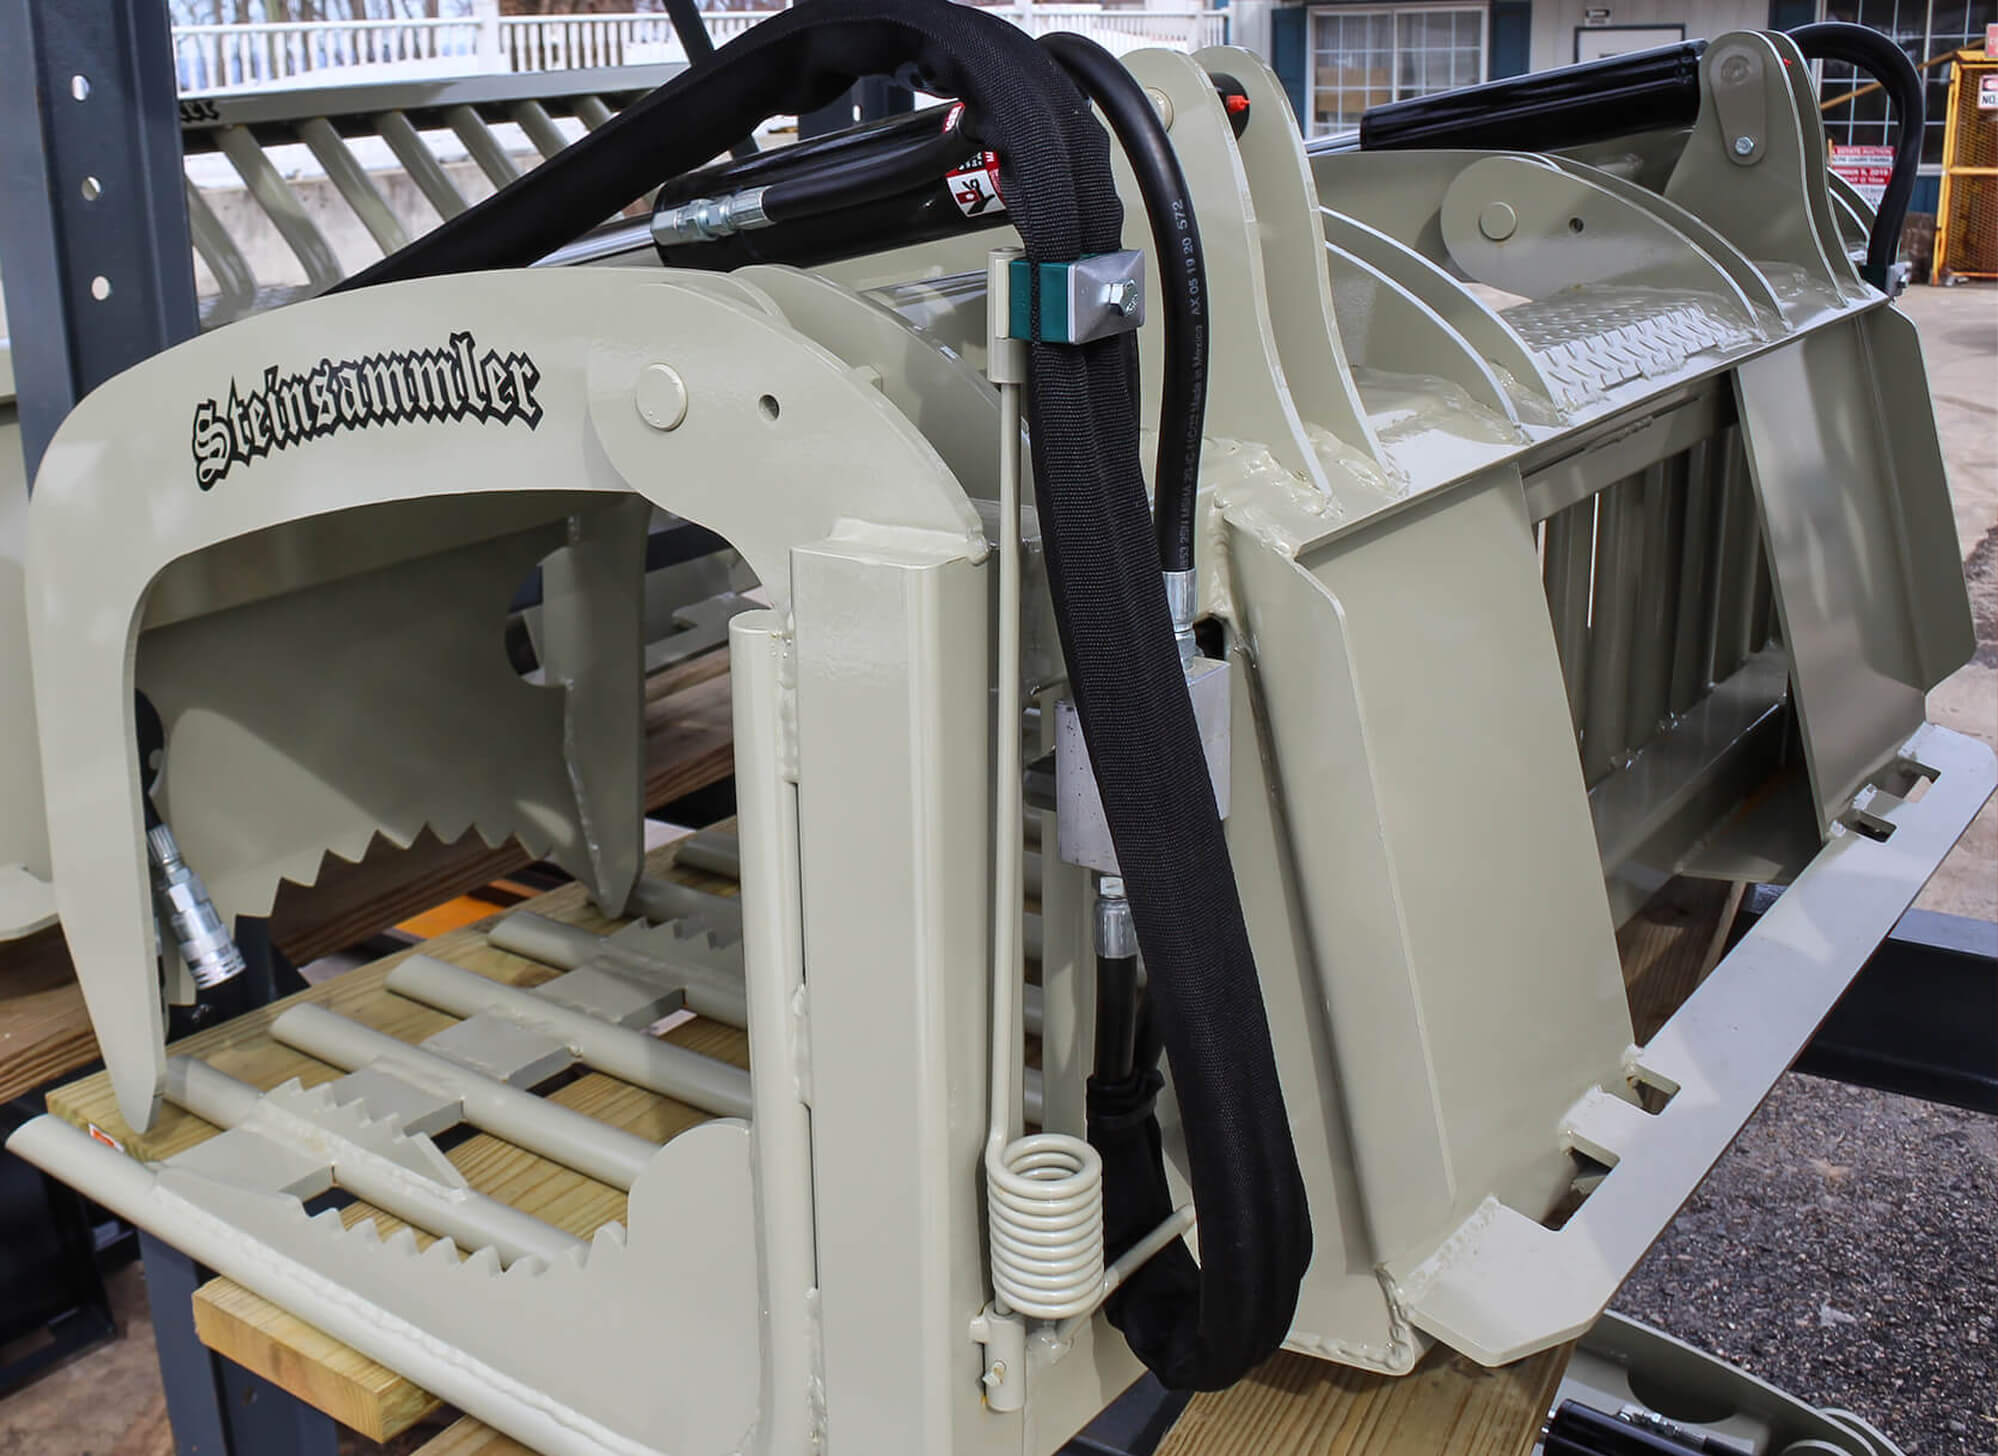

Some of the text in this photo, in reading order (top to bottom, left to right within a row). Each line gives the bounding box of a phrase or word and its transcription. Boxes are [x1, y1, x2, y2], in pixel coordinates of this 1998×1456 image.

[1171, 198, 1189, 231] 572
[1181, 236, 1193, 255] 20
[1188, 278, 1200, 295] 05
[192, 331, 544, 492] Steinsammler
